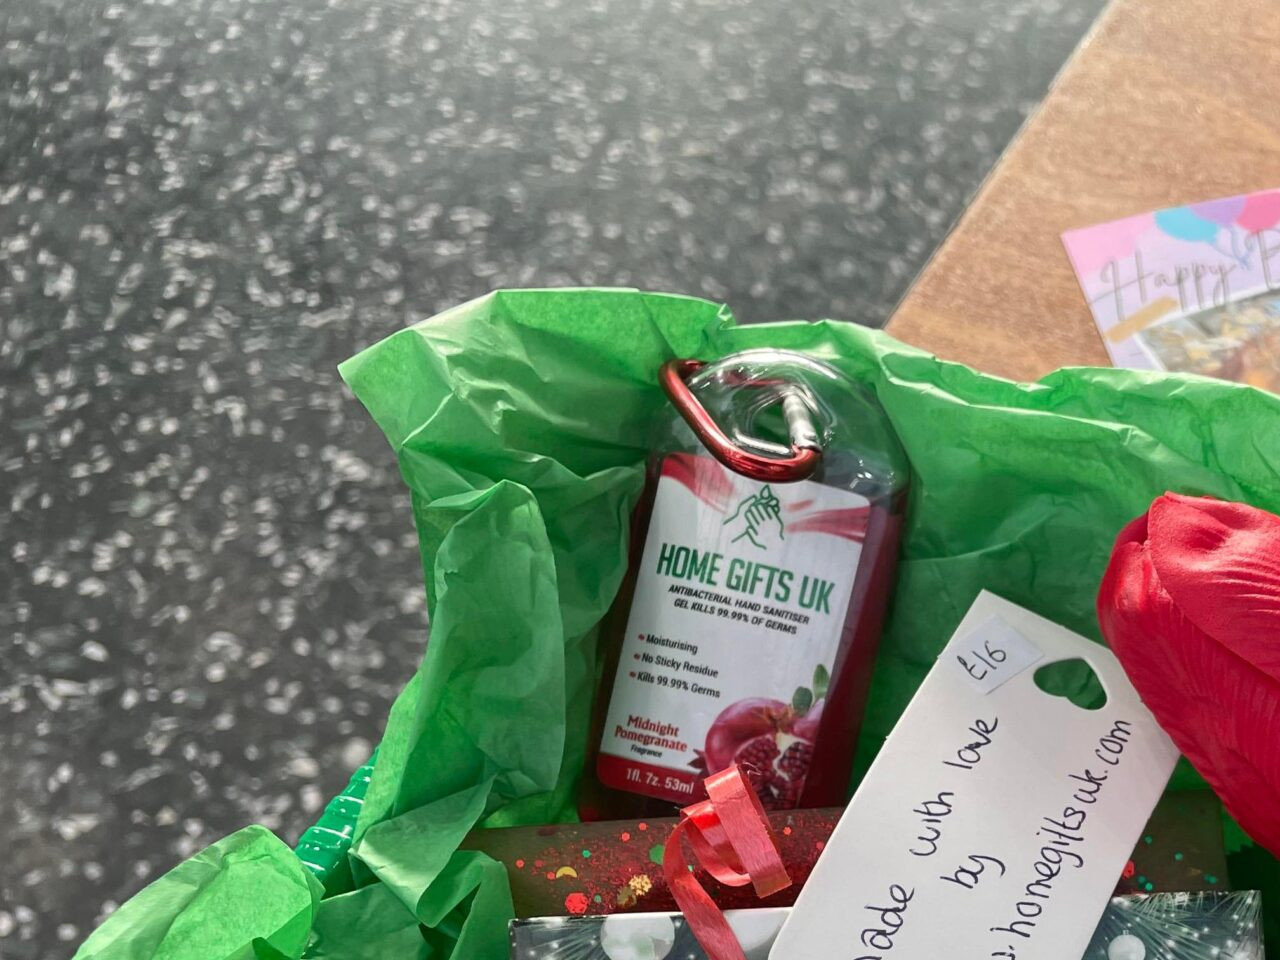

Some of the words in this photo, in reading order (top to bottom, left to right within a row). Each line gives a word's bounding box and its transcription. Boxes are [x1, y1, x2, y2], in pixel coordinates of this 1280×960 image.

[1091, 248, 1236, 322] Happy
[656, 543, 723, 585] HOME
[726, 559, 794, 602] GIFTS
[799, 576, 835, 614] UK
[669, 585, 732, 606] ANTIBACTERIAL
[735, 599, 761, 612] HAND
[763, 606, 810, 625] SANITISER
[674, 599, 689, 610] GEL
[691, 602, 716, 615] KILLS
[717, 607, 750, 622] 99.99%
[751, 615, 763, 626] OF
[765, 620, 798, 635] GERMS
[646, 634, 698, 655] Moisturising
[642, 653, 653, 664] No
[655, 656, 682, 671] Sticky
[683, 661, 719, 678] Residue
[956, 640, 1007, 681] £16
[637, 671, 655, 684] Kills
[657, 675, 689, 691] 99.99%
[691, 683, 721, 698] Germs
[614, 725, 688, 752] Pomegranate
[627, 715, 680, 737] Midnight
[631, 744, 663, 758] Fragrance
[664, 776, 695, 795] 53ml
[909, 791, 954, 857] with
[943, 717, 998, 770] love
[940, 855, 1006, 889] by
